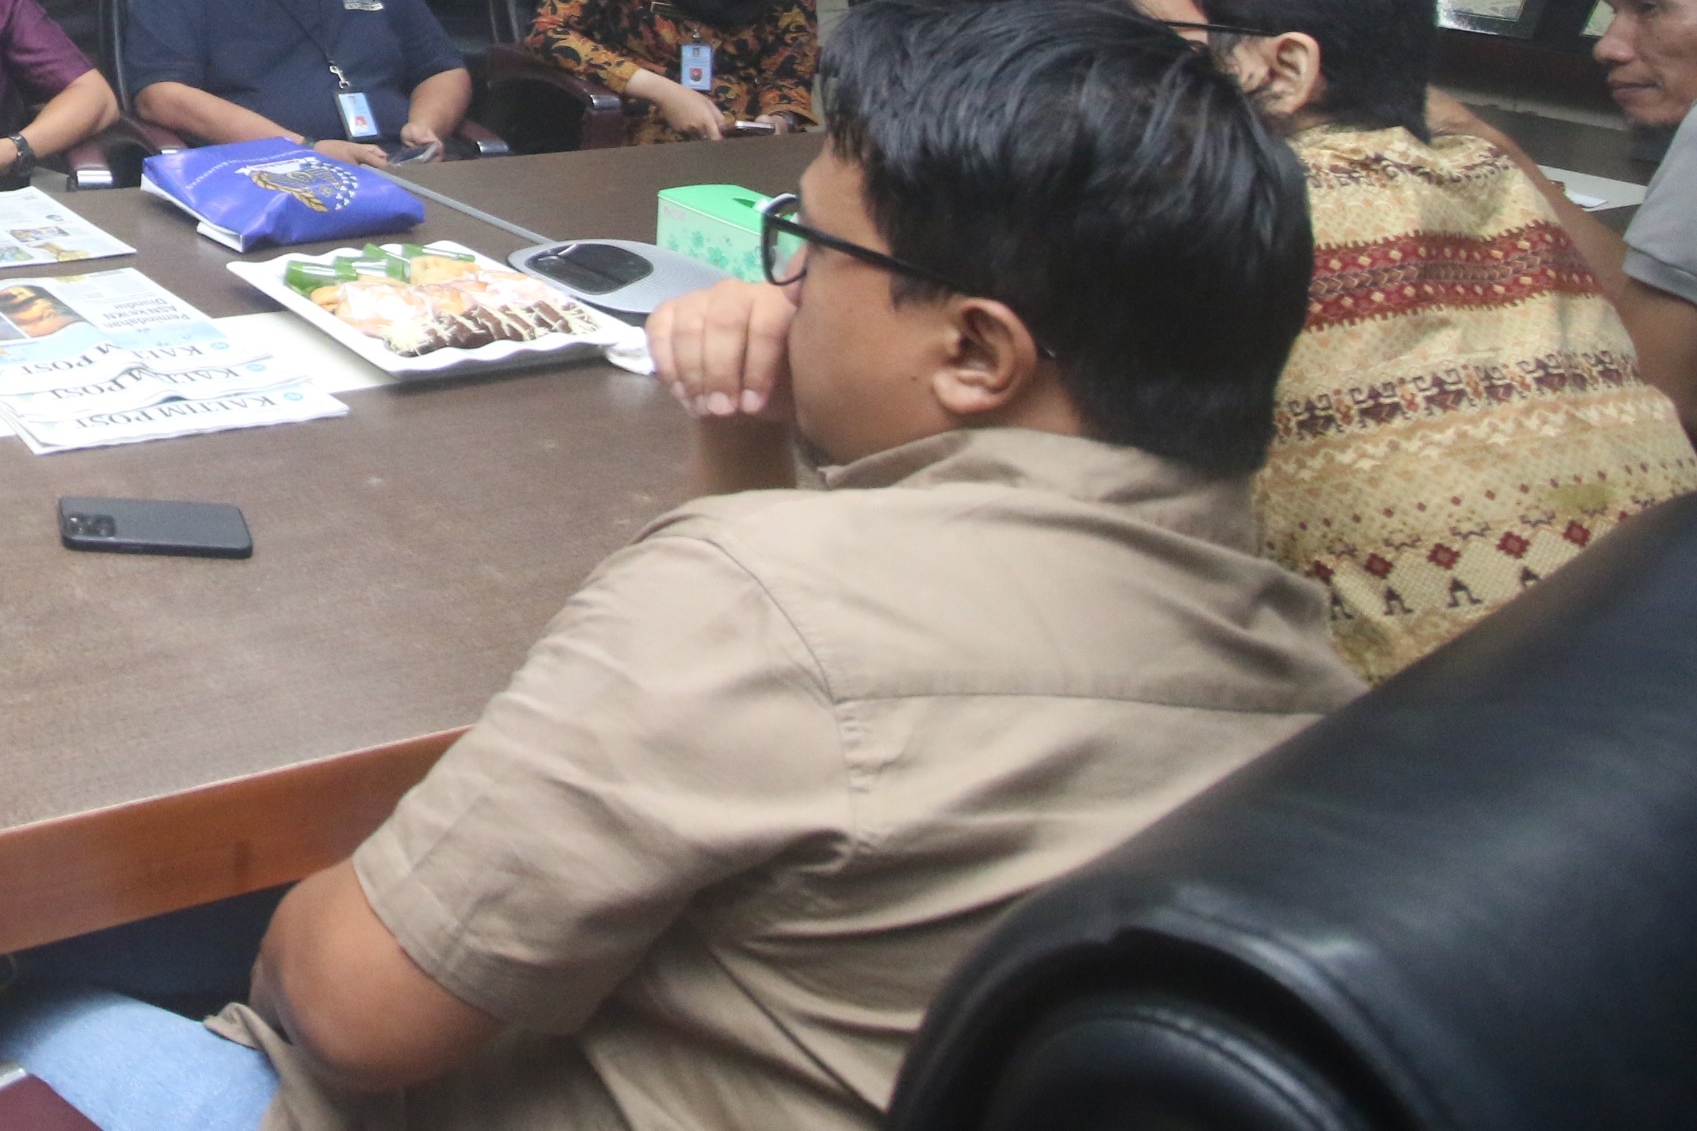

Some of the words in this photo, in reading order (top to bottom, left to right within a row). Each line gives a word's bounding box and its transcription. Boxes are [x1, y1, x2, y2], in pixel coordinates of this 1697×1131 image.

[96, 342, 204, 360] KALTM
[21, 359, 95, 375] POST
[50, 378, 127, 399] POST
[155, 395, 277, 418] KALTIM
[75, 408, 154, 429] POST
